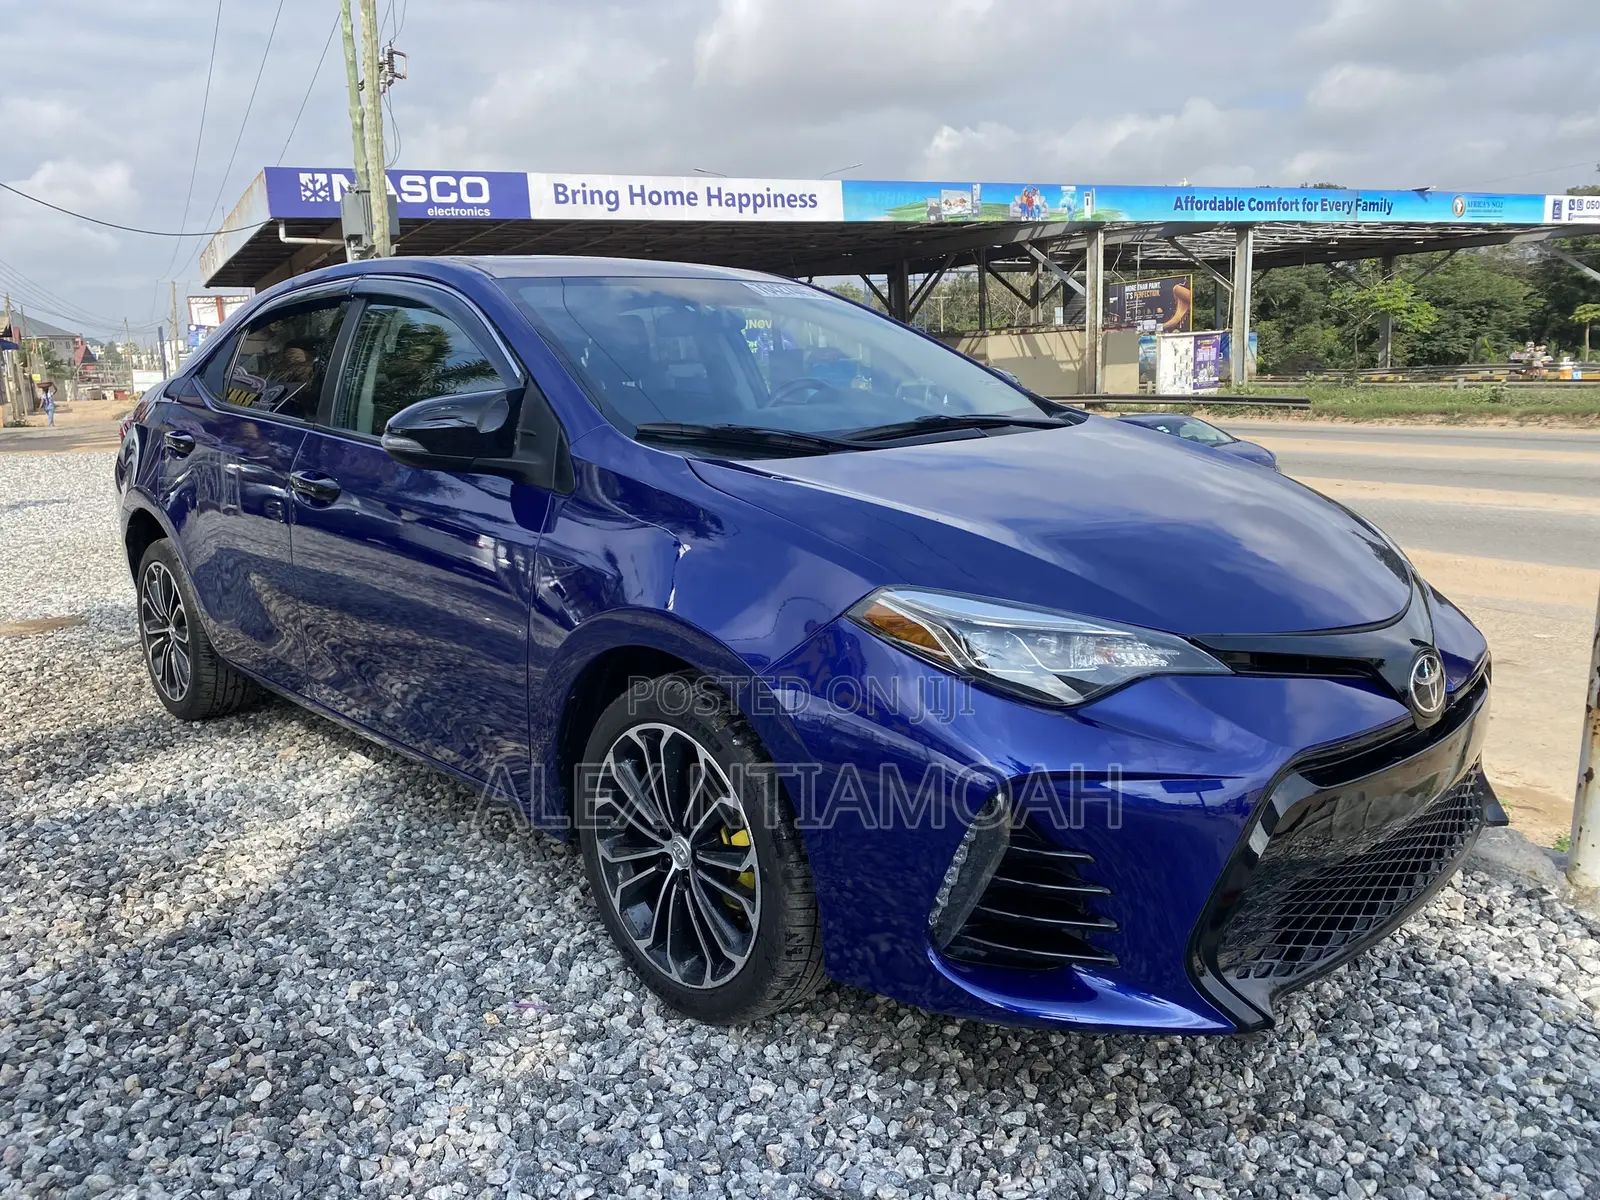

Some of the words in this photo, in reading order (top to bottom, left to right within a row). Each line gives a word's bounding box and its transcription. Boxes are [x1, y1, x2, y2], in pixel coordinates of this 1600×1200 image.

[553, 183, 620, 212] Bring
[628, 184, 699, 206] Home
[706, 186, 818, 214] Happiness
[1173, 196, 1246, 212] Affordable
[1248, 197, 1300, 212] Comfort
[1302, 198, 1319, 212] for
[1320, 198, 1354, 215] Every
[1356, 198, 1394, 216] Family
[427, 206, 491, 217] electronics
